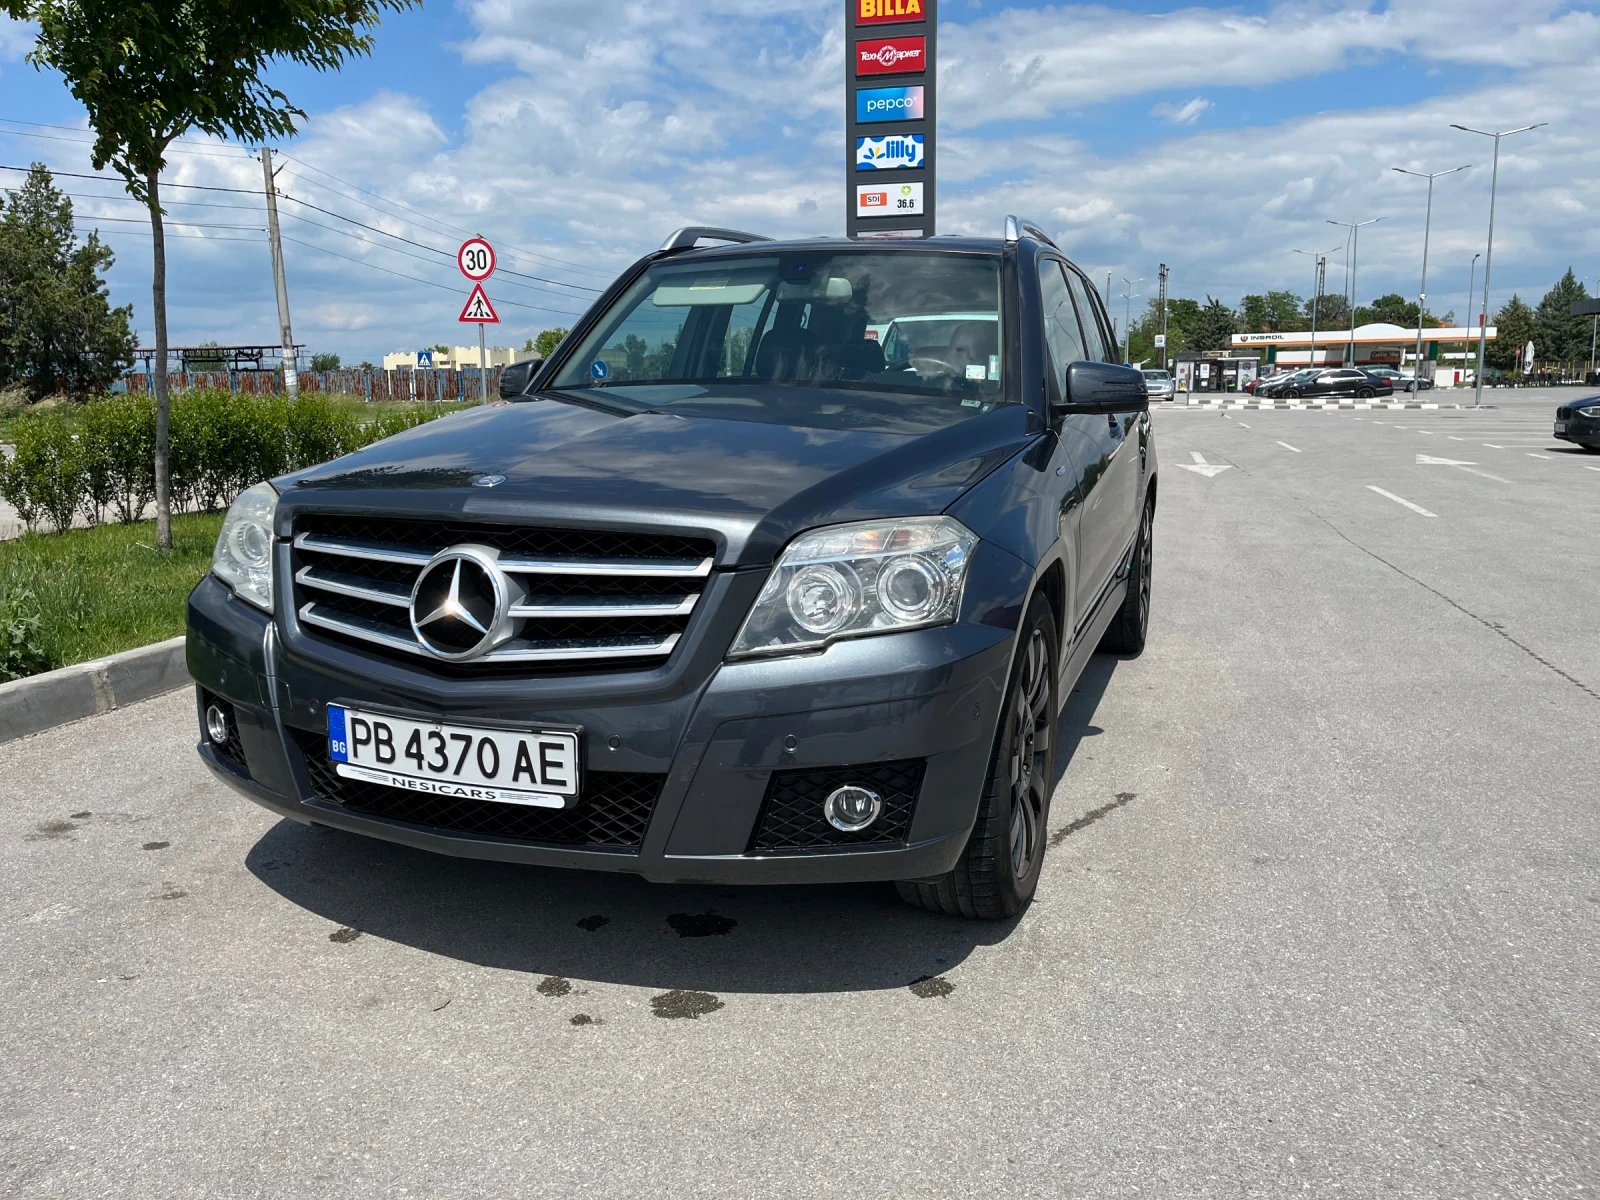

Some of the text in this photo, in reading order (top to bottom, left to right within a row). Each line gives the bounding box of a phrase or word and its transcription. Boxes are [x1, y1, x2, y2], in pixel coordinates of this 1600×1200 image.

[860, 0, 921, 18] BILLA
[867, 98, 914, 112] pepco
[886, 140, 916, 162] lilly
[465, 249, 487, 271] 30
[332, 740, 346, 754] BG
[350, 717, 567, 787] PB 4370 AE
[392, 776, 497, 800] NESICARS
